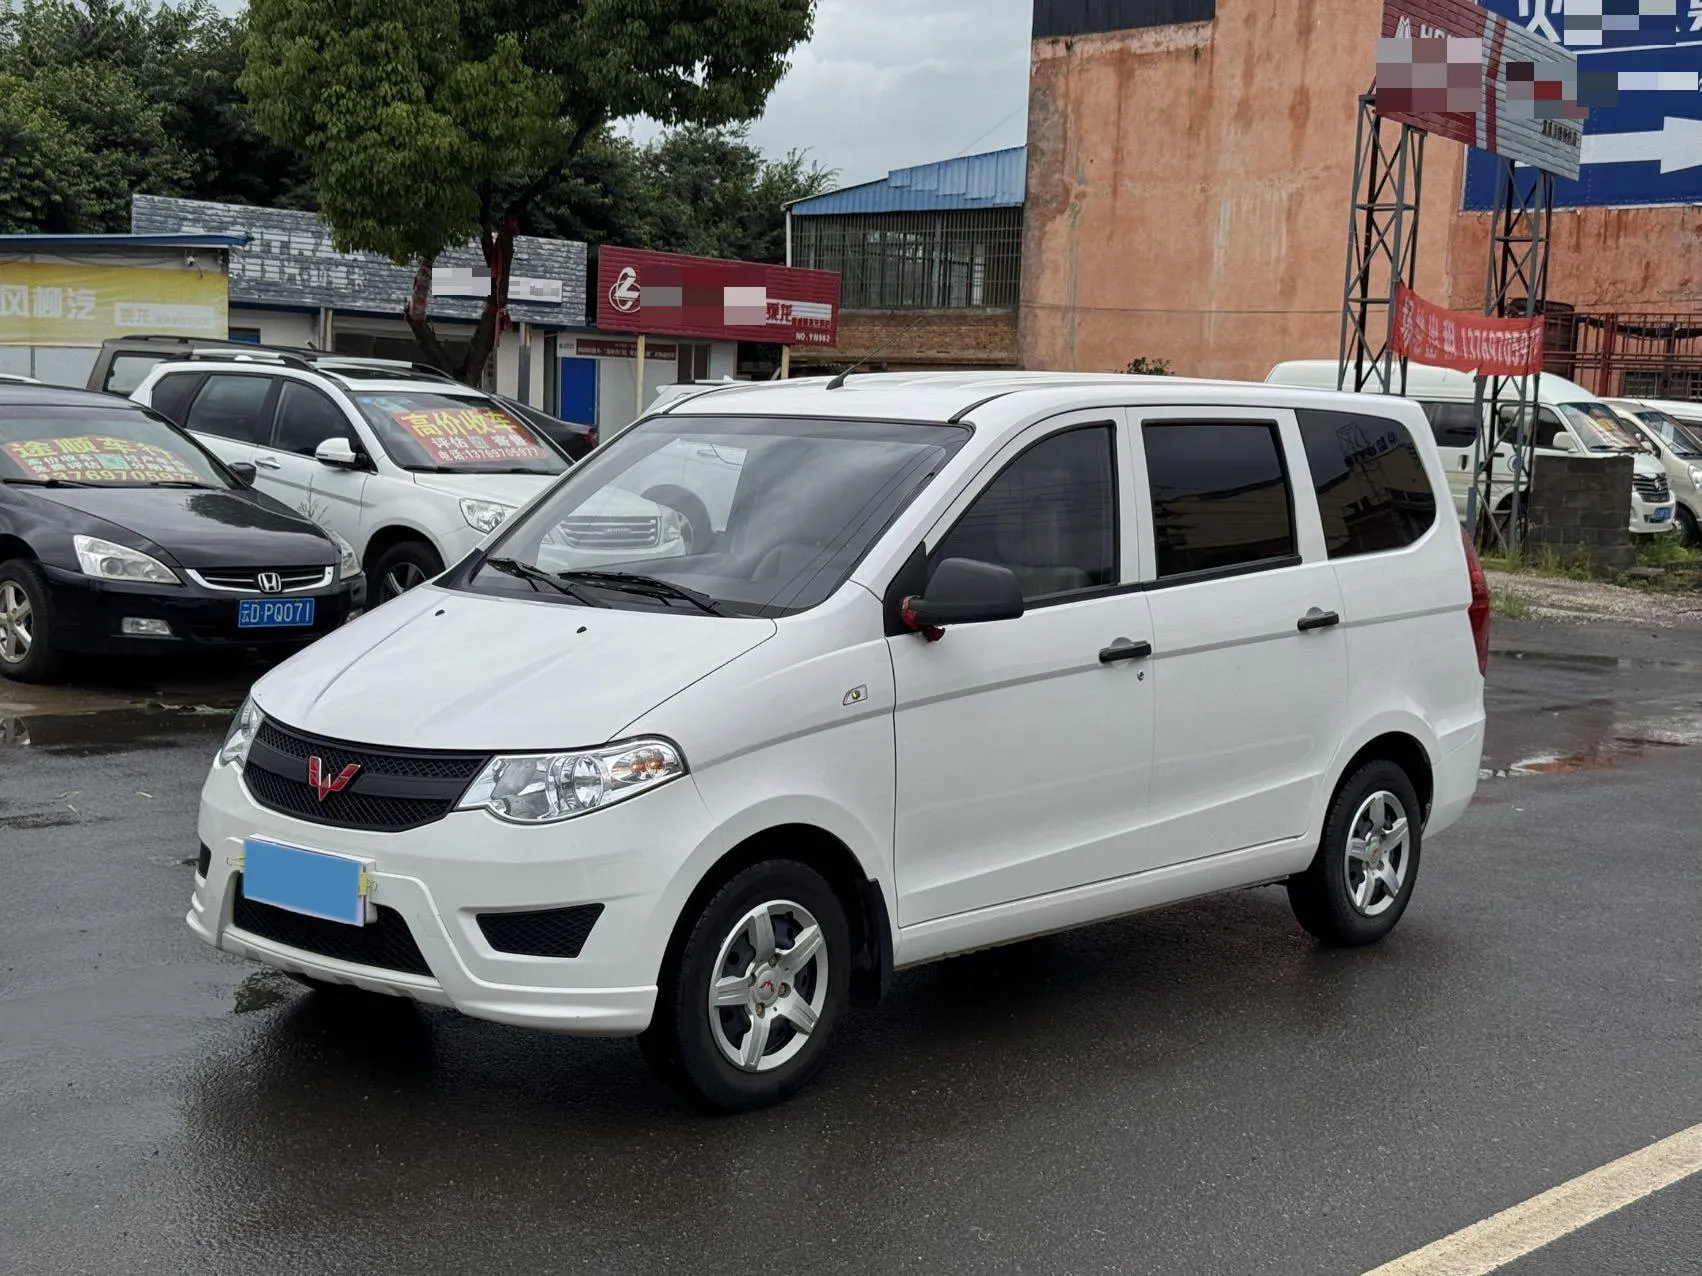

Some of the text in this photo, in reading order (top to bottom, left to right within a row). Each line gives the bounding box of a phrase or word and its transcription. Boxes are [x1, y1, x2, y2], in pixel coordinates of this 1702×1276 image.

[401, 410, 518, 436] 高价收车
[432, 436, 469, 449] 评估
